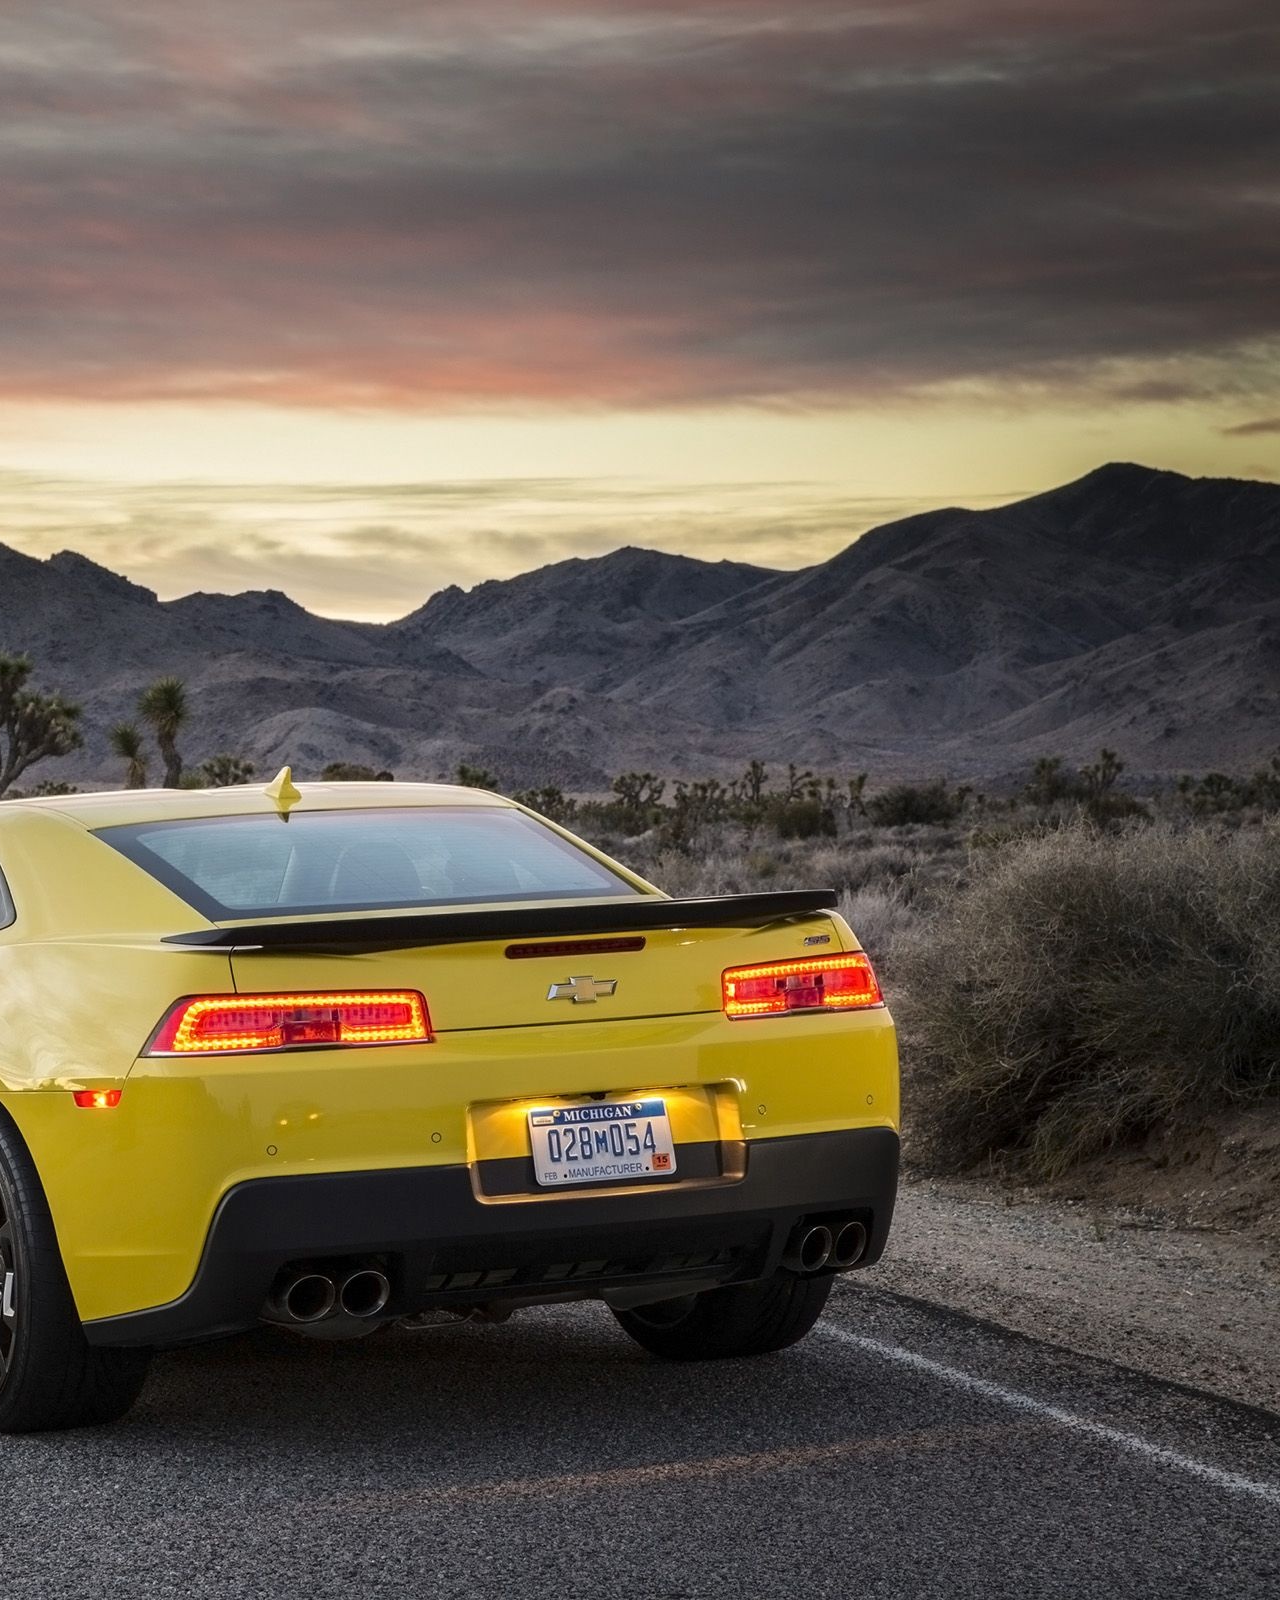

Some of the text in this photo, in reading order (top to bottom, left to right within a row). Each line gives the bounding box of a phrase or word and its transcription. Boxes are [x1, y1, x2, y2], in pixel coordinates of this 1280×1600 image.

[564, 1105, 632, 1122] MICHIGAN
[548, 1121, 656, 1163] 028M054
[657, 1155, 668, 1164] 15
[544, 1172, 558, 1181] FEB
[569, 1163, 643, 1178] MANUFACTURER
